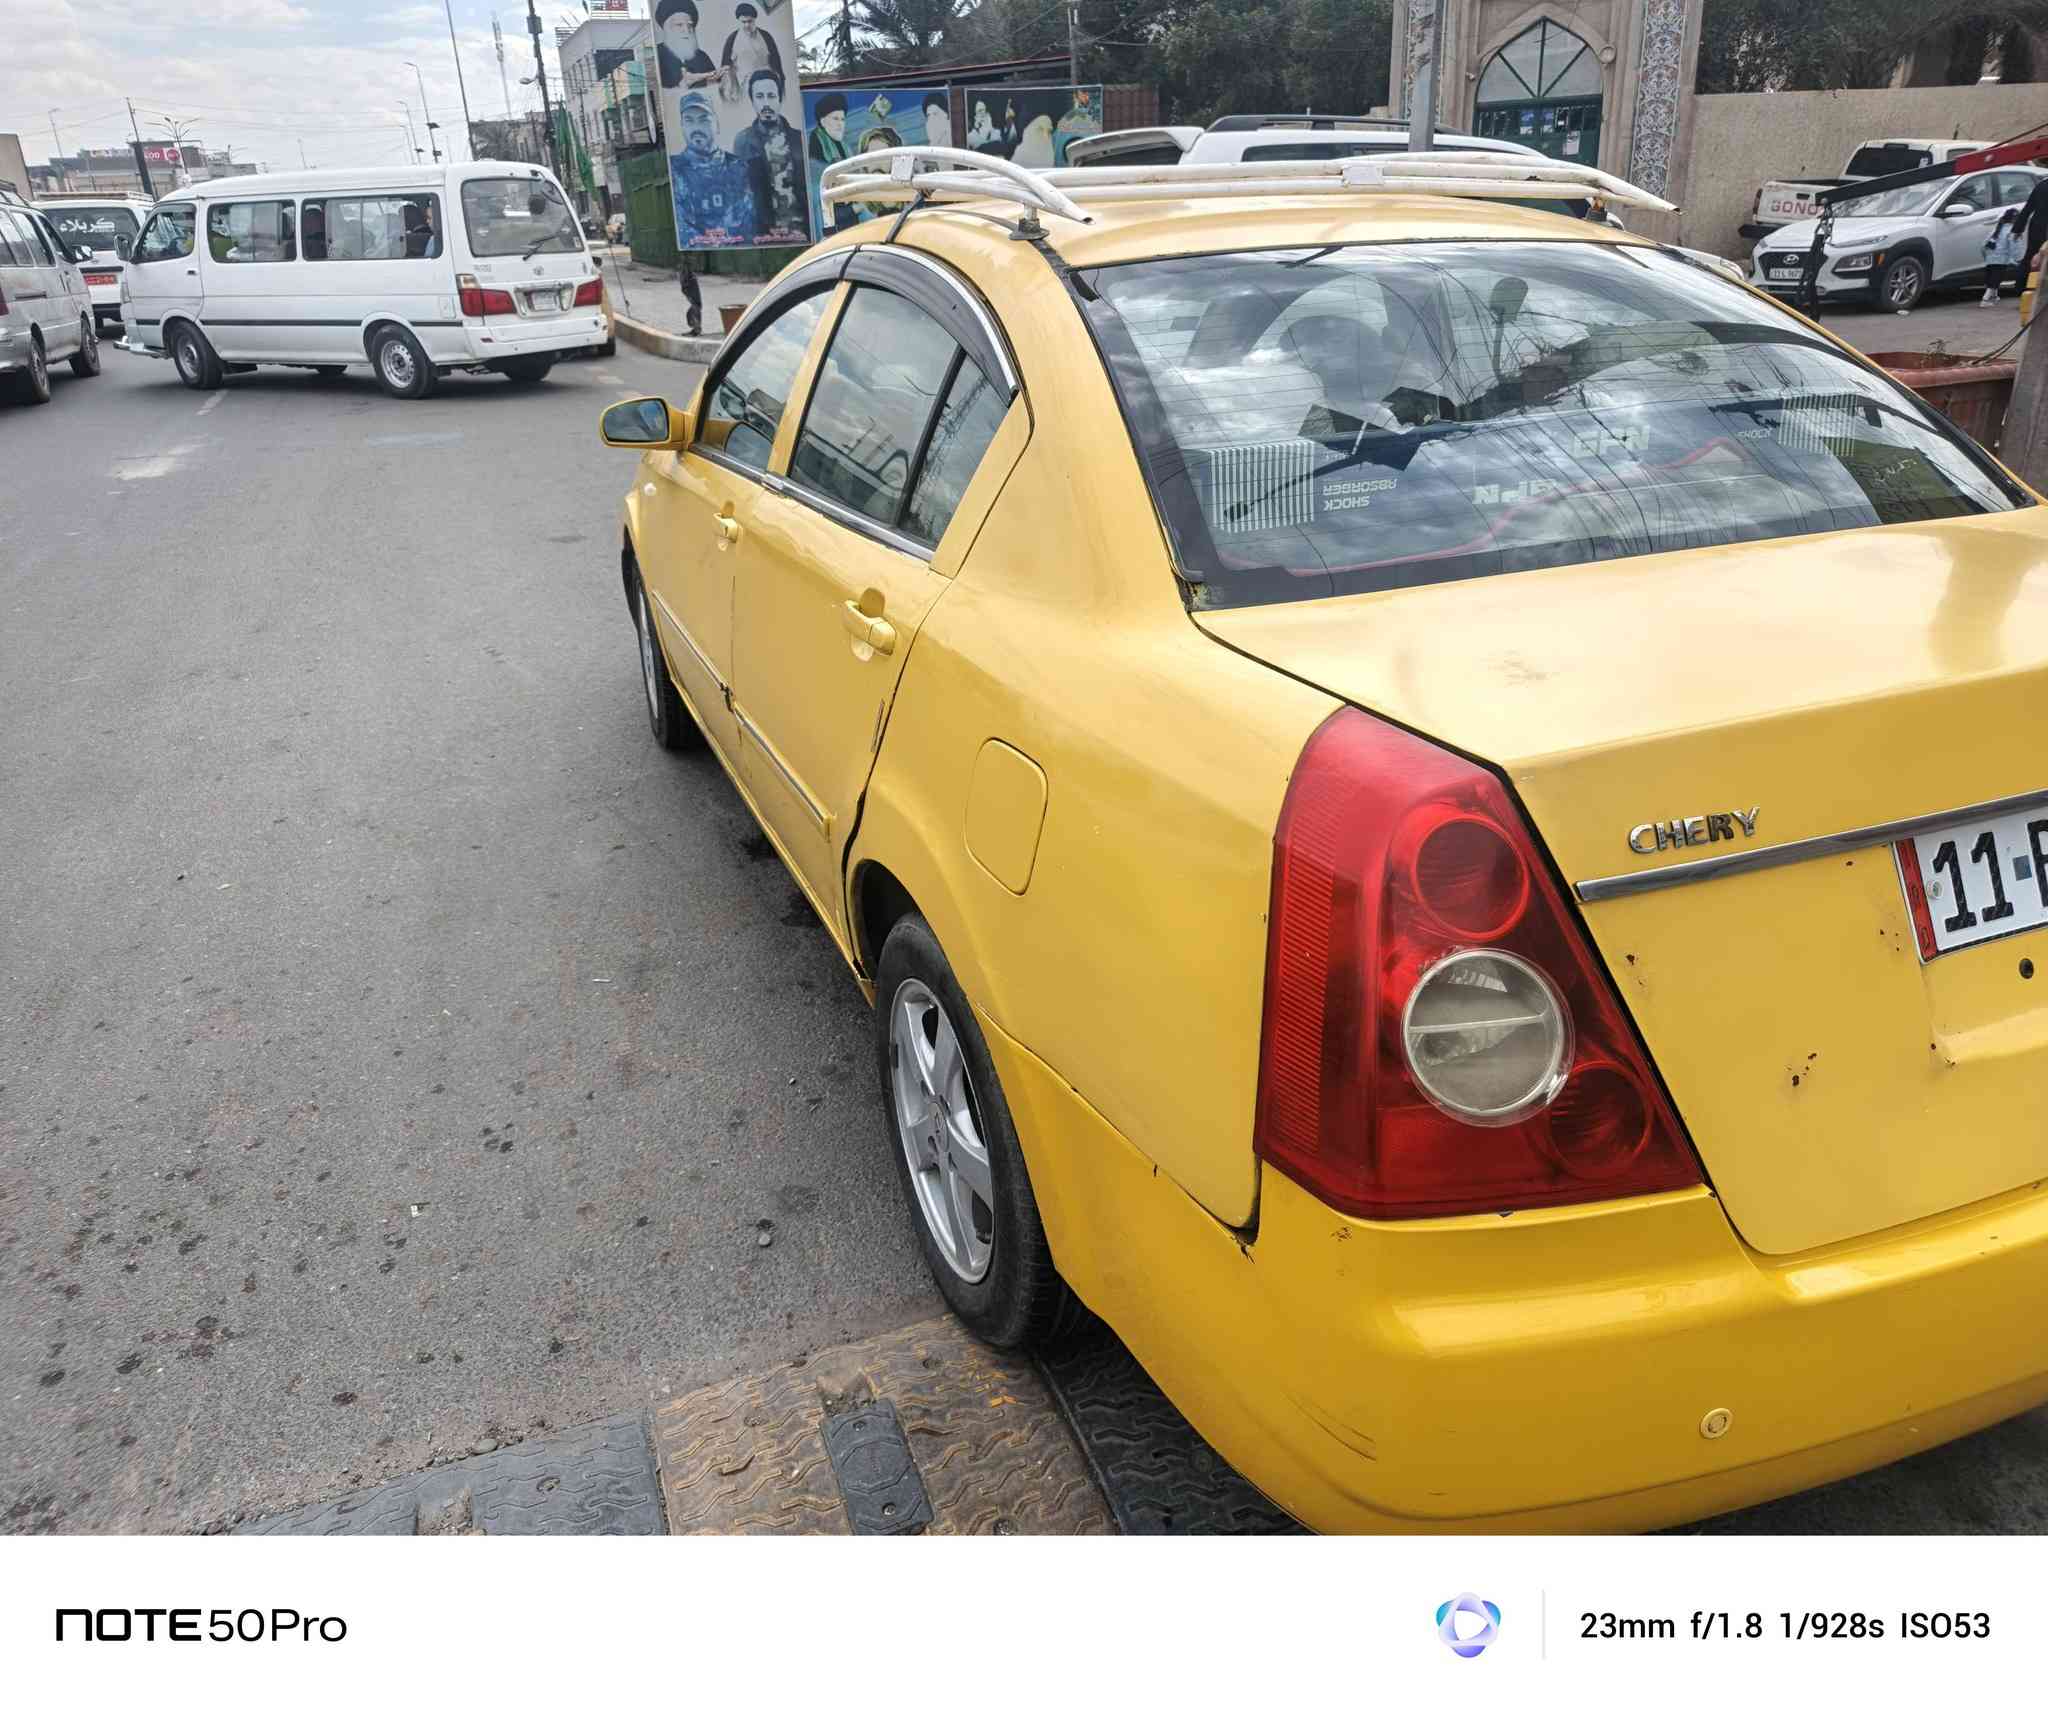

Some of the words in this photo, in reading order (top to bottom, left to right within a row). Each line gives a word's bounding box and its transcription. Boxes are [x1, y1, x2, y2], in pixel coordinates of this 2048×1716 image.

[1771, 200, 1820, 216] GONO
[59, 217, 116, 234] كربلاء
[1323, 478, 1398, 496] ABSORBER
[1323, 495, 1371, 512] SHOCK
[1628, 806, 1760, 855] CHERY
